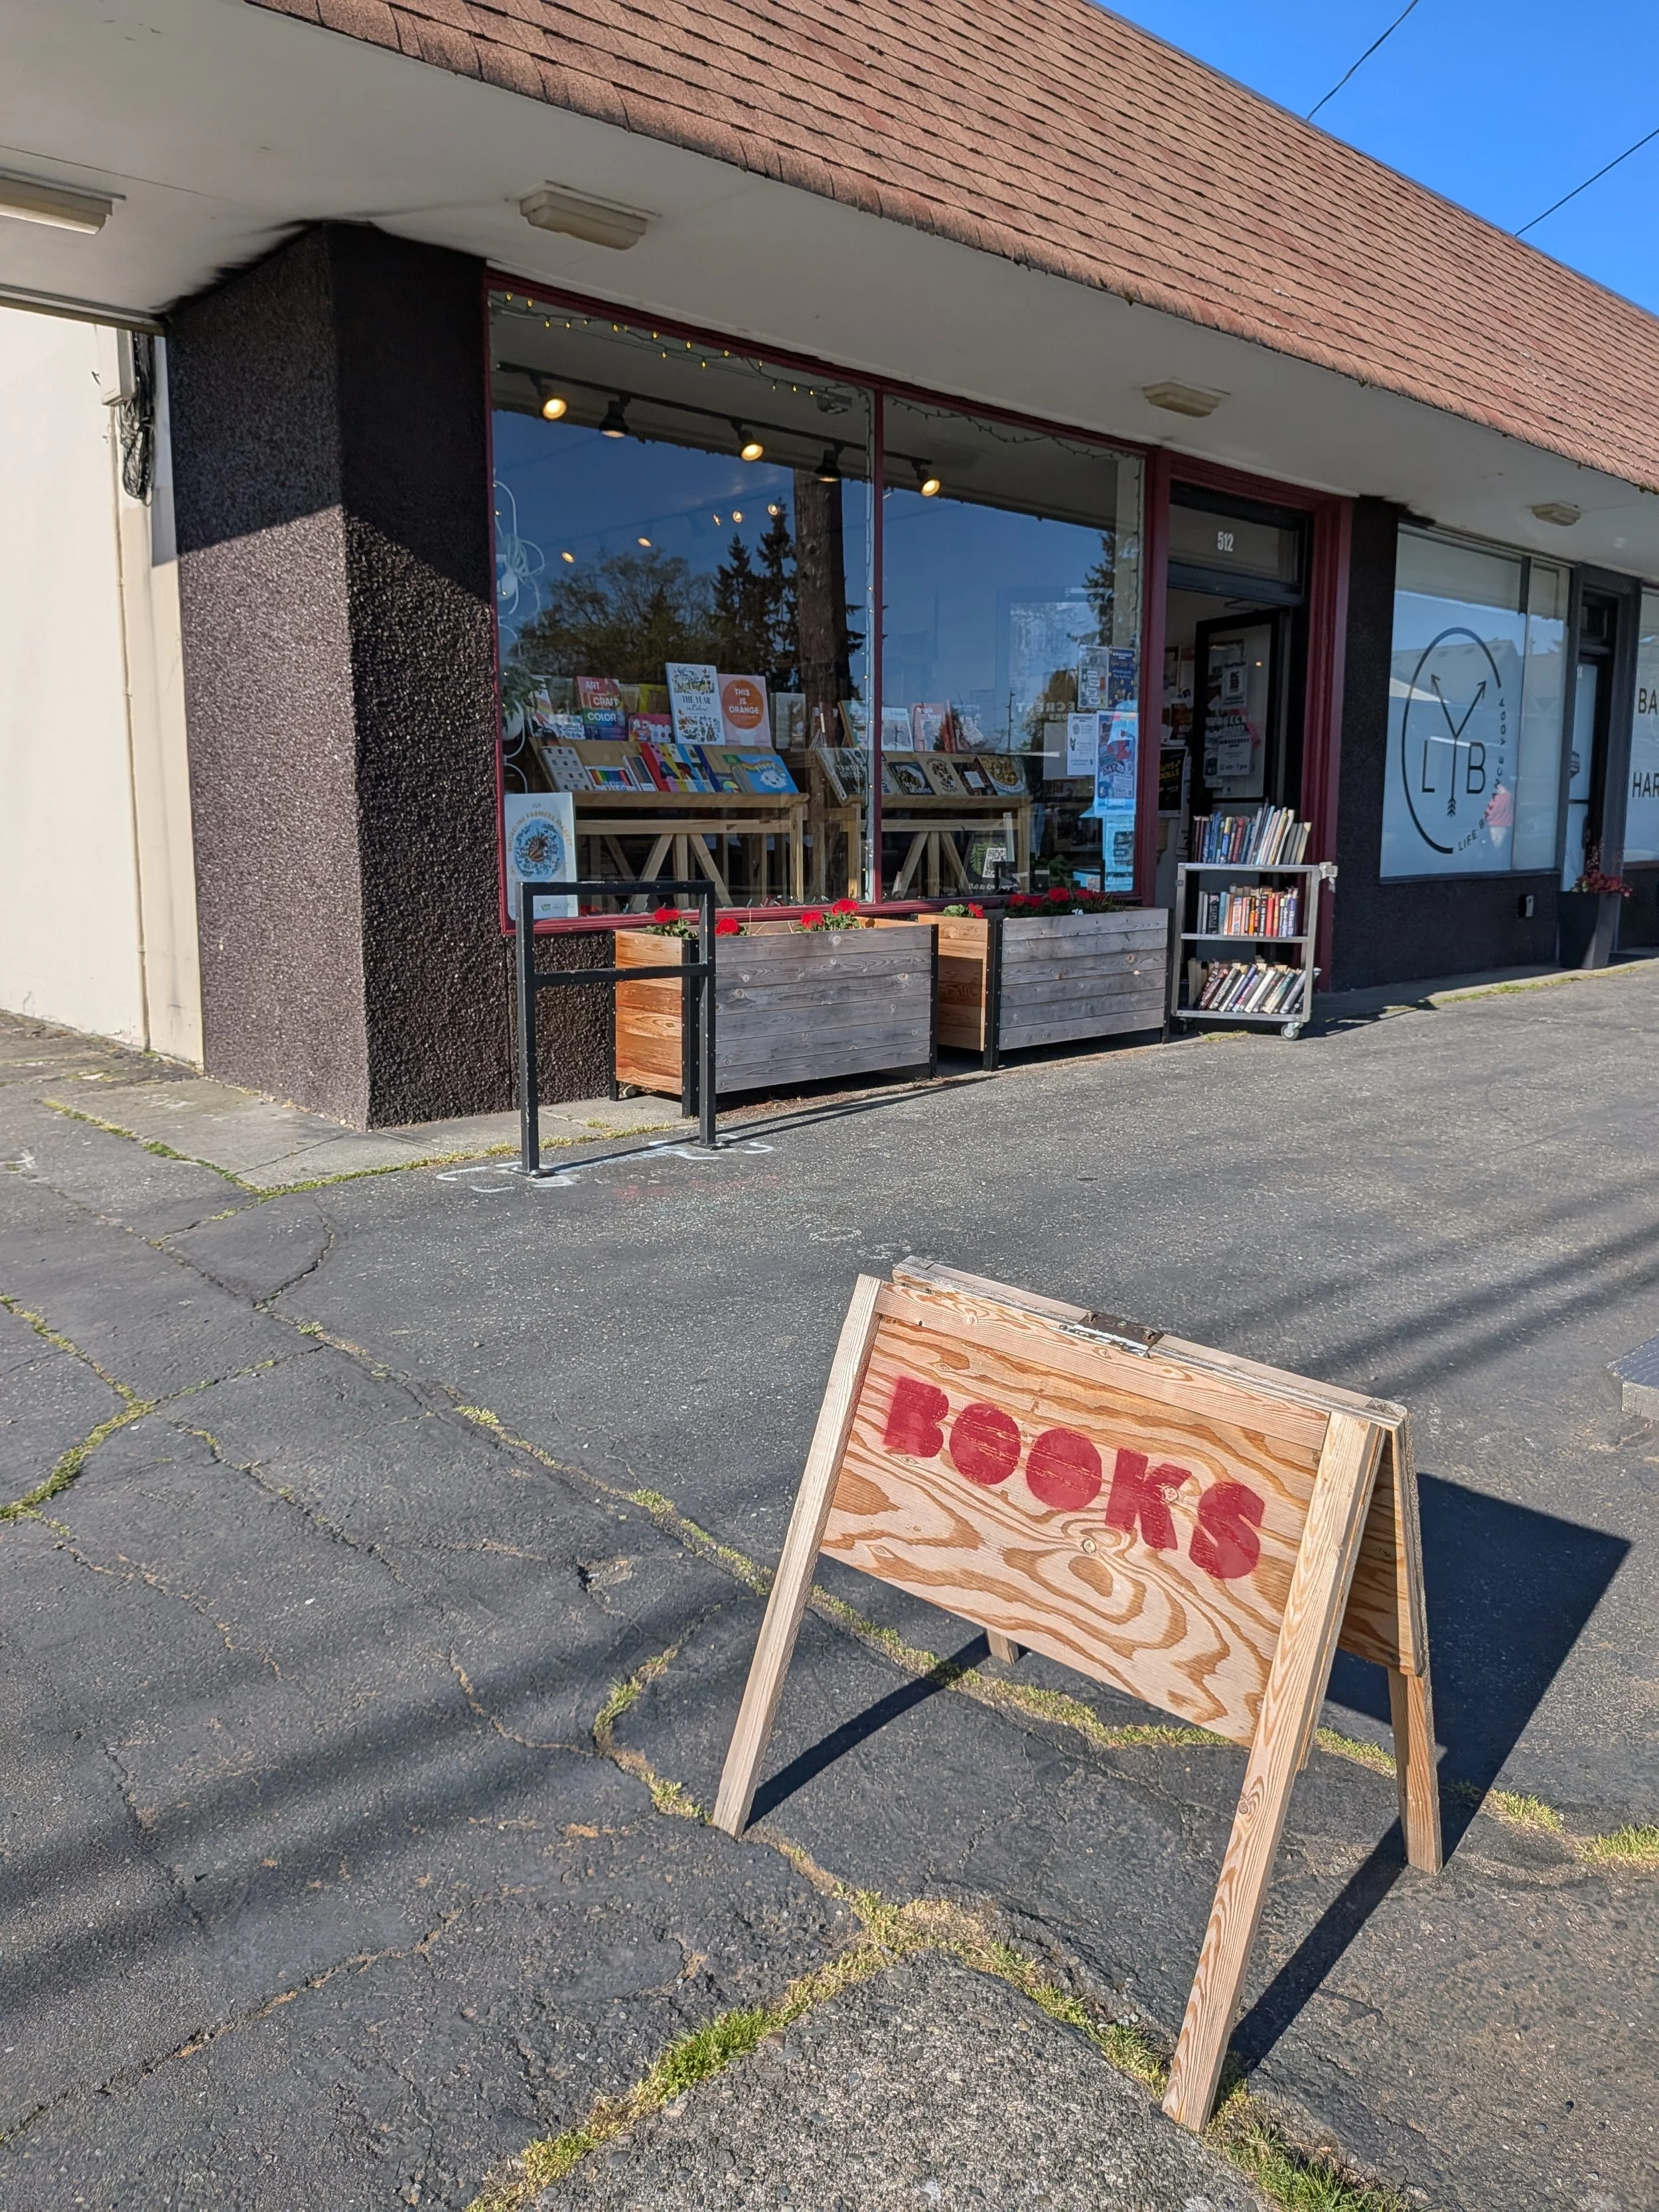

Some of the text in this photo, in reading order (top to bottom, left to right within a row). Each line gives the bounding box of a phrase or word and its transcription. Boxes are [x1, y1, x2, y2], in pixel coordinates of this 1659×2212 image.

[1217, 532, 1234, 553] 512
[585, 681, 600, 690] ART
[593, 696, 620, 707] CRAFT
[695, 696, 711, 704] YEAR
[729, 705, 759, 714] ORANGE
[587, 712, 617, 722] COLOR
[1457, 697, 1507, 852] LIFE BALANCE YOGA
[884, 1375, 1266, 1580] BOOKS
